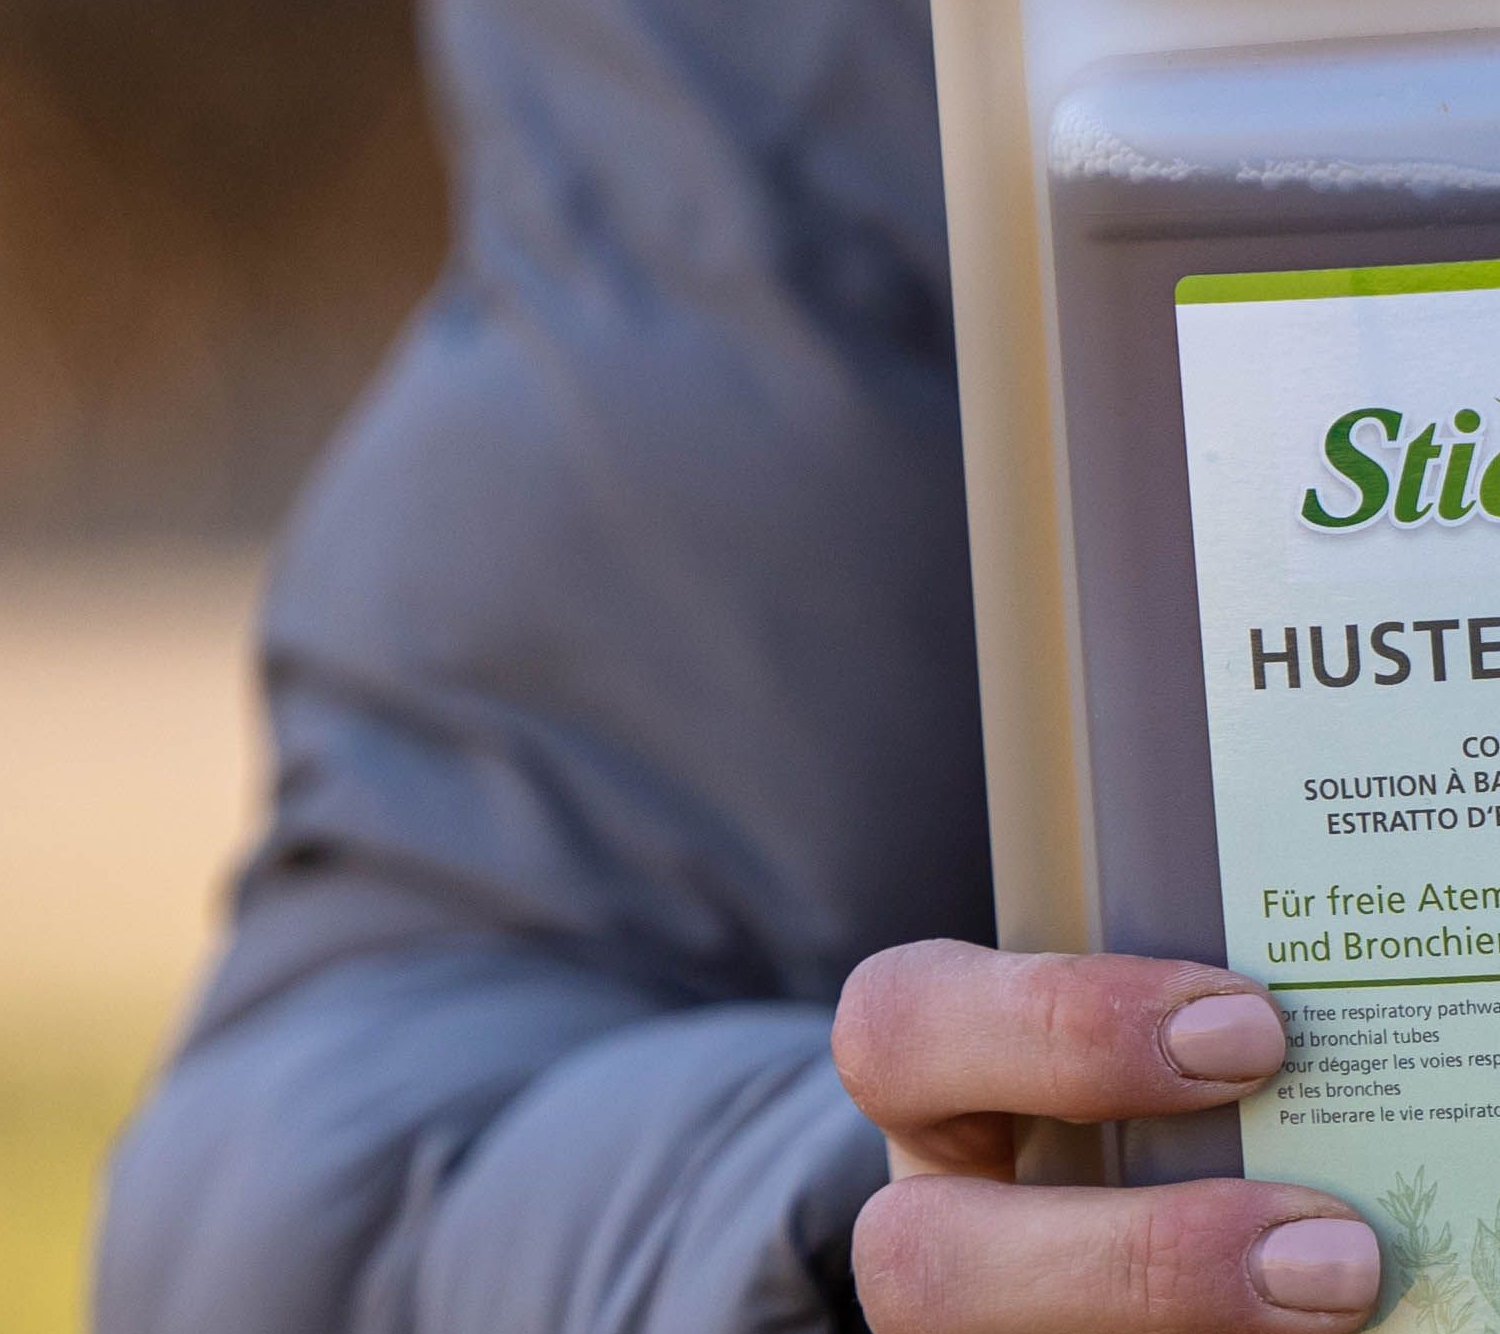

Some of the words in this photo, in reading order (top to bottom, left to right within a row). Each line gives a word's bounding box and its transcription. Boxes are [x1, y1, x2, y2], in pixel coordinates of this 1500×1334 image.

[1303, 773, 1438, 802] SOLUTION
[1445, 766, 1467, 795] À
[1326, 807, 1459, 835] ESTRATTO
[1262, 888, 1316, 919] Für
[1325, 884, 1406, 916] freie
[1267, 930, 1332, 964] und
[1282, 1009, 1299, 1027] or
[1302, 1005, 1337, 1022] free
[1341, 1003, 1433, 1024] respiratory
[1286, 1031, 1305, 1048] nd
[1309, 1027, 1388, 1048] bronchial
[1391, 1027, 1441, 1045] tubes
[1282, 1058, 1314, 1074] our
[1318, 1056, 1389, 1076] dégager
[1392, 1053, 1416, 1070] les
[1419, 1051, 1463, 1069] voies
[1276, 1085, 1295, 1100] et
[1298, 1082, 1322, 1099] les
[1325, 1080, 1402, 1098] bronches
[1279, 1109, 1307, 1126] Per
[1310, 1107, 1376, 1124] liberare
[1379, 1106, 1396, 1122] le
[1398, 1104, 1424, 1122] vie
